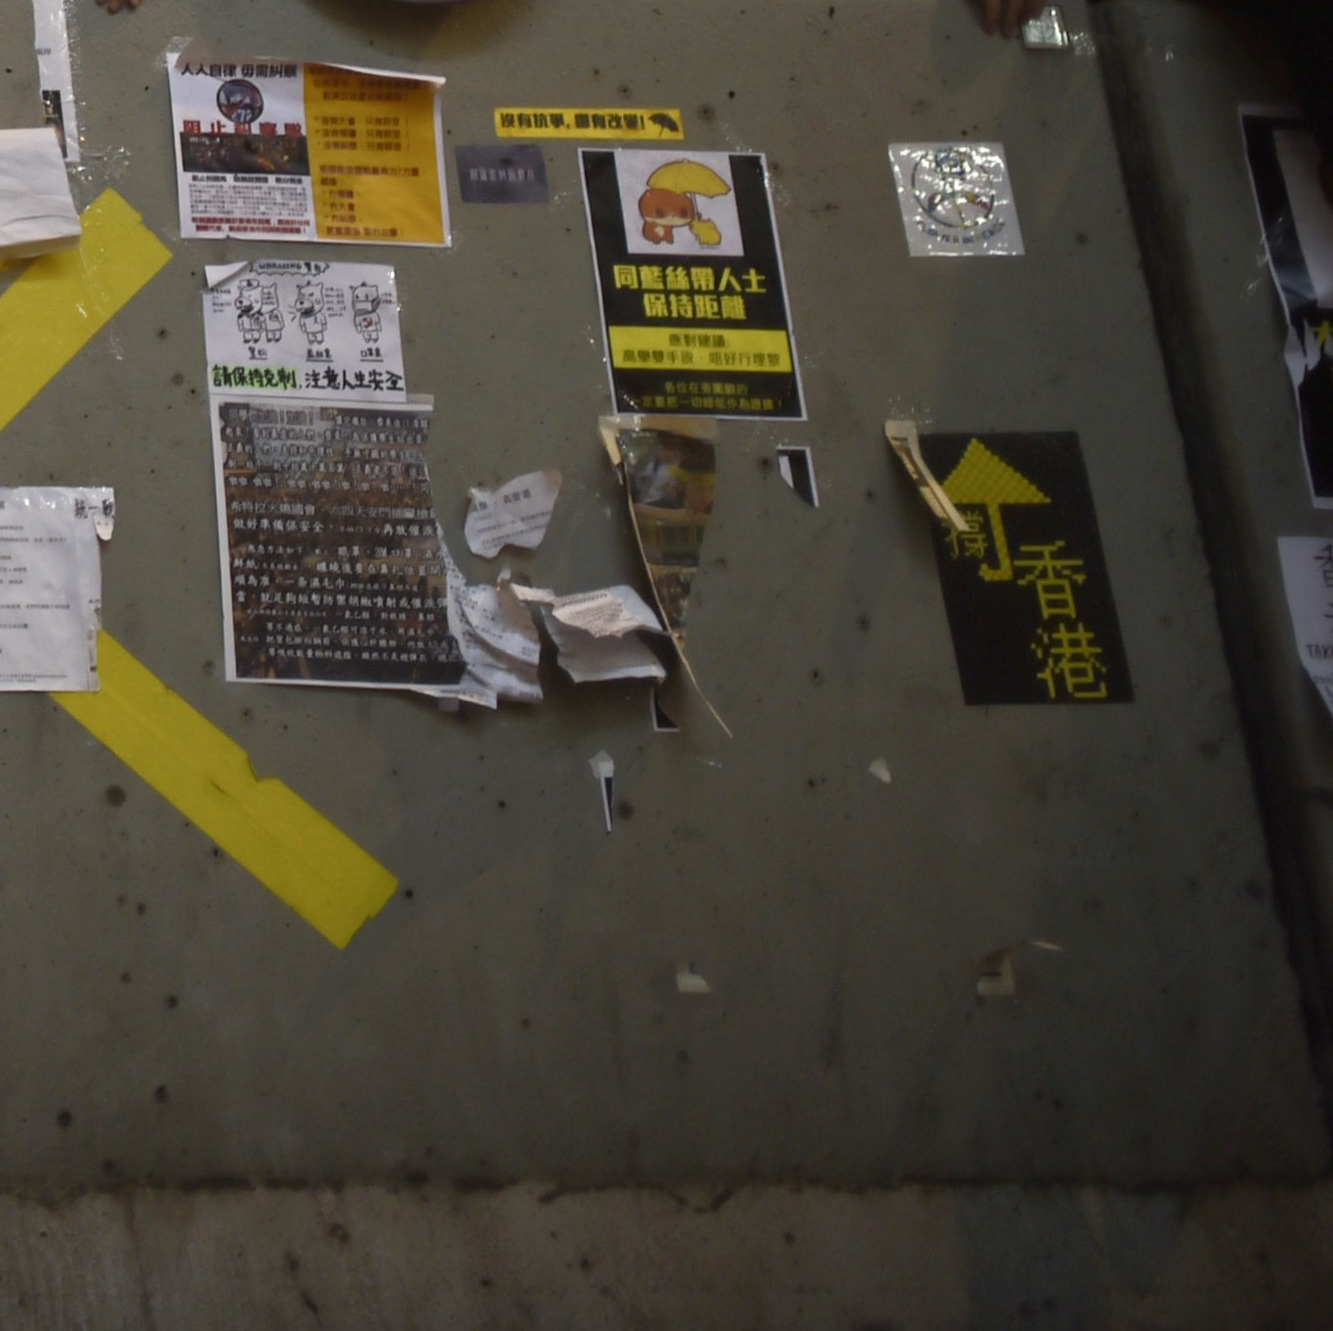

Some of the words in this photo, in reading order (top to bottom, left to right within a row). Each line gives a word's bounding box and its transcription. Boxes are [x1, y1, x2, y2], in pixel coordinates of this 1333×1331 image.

[613, 264, 767, 294] 同藍絲帶人士
[643, 293, 747, 320] 保持距離
[1013, 540, 1109, 700] 香港
